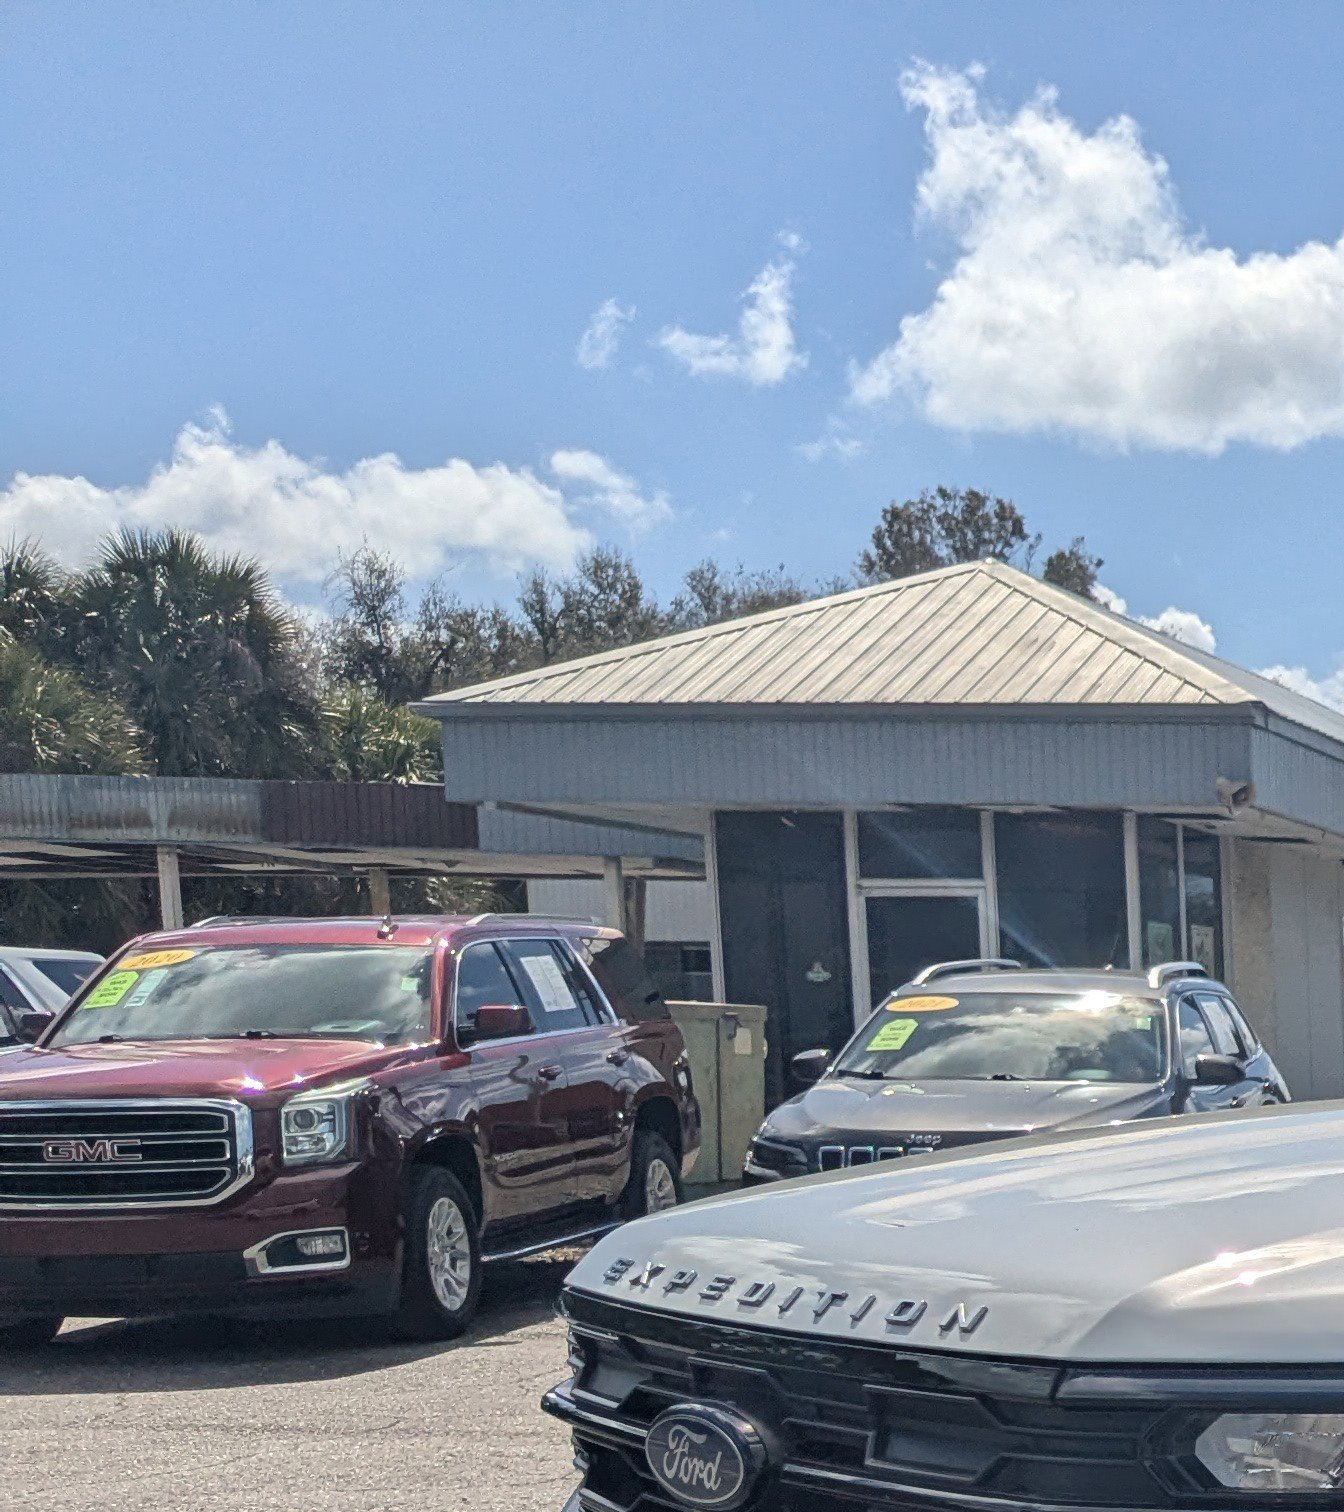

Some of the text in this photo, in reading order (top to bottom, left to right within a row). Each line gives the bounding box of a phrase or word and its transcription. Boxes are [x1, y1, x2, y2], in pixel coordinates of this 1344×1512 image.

[43, 1139, 142, 1161] GMC
[905, 1134, 942, 1145] Jeep
[603, 1257, 989, 1334] EXPEDITION
[662, 1424, 723, 1491] Ford
